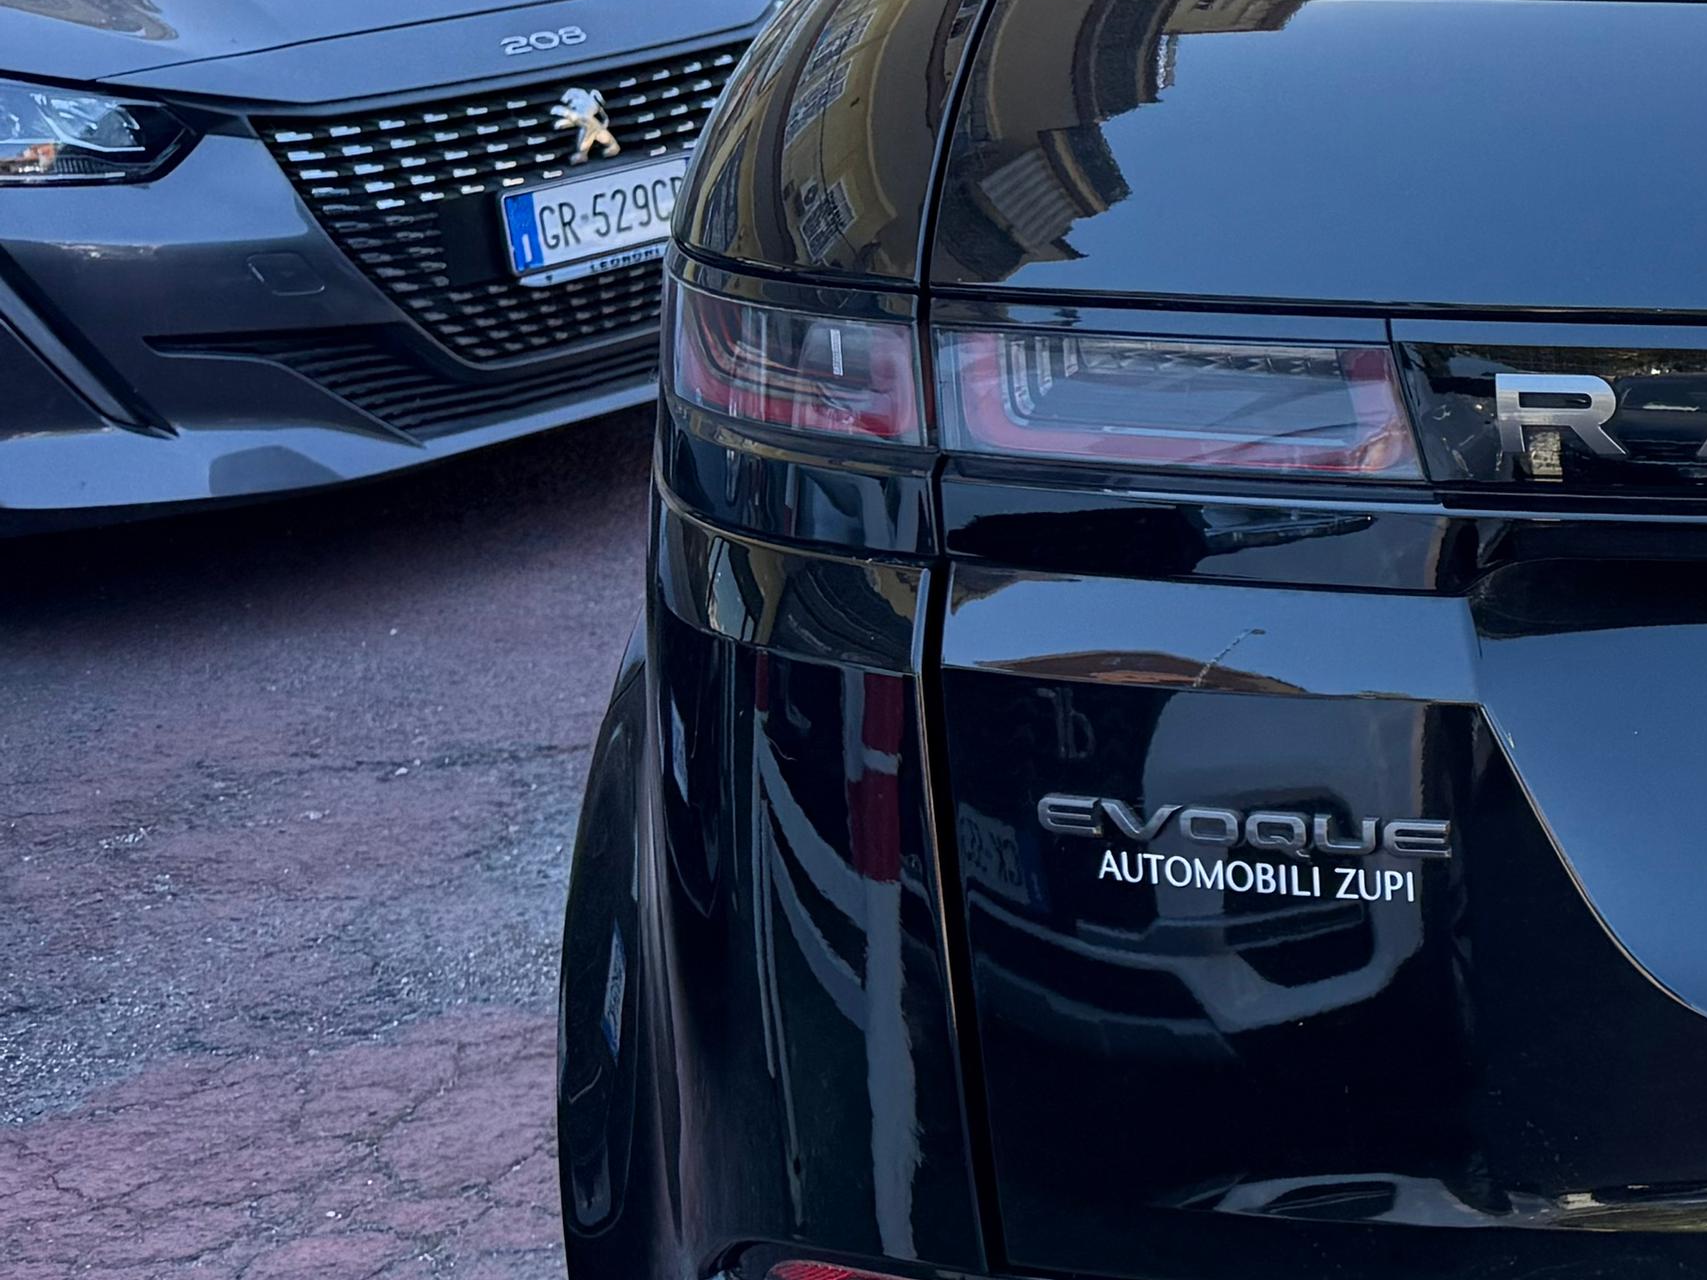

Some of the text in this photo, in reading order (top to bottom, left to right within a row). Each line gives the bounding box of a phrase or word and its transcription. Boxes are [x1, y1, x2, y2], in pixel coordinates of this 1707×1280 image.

[501, 26, 587, 55] 208
[538, 201, 581, 250] GR
[1037, 793, 1452, 858] EVOQUE
[1098, 850, 1415, 903] AUTOMOBILI ZUPI
